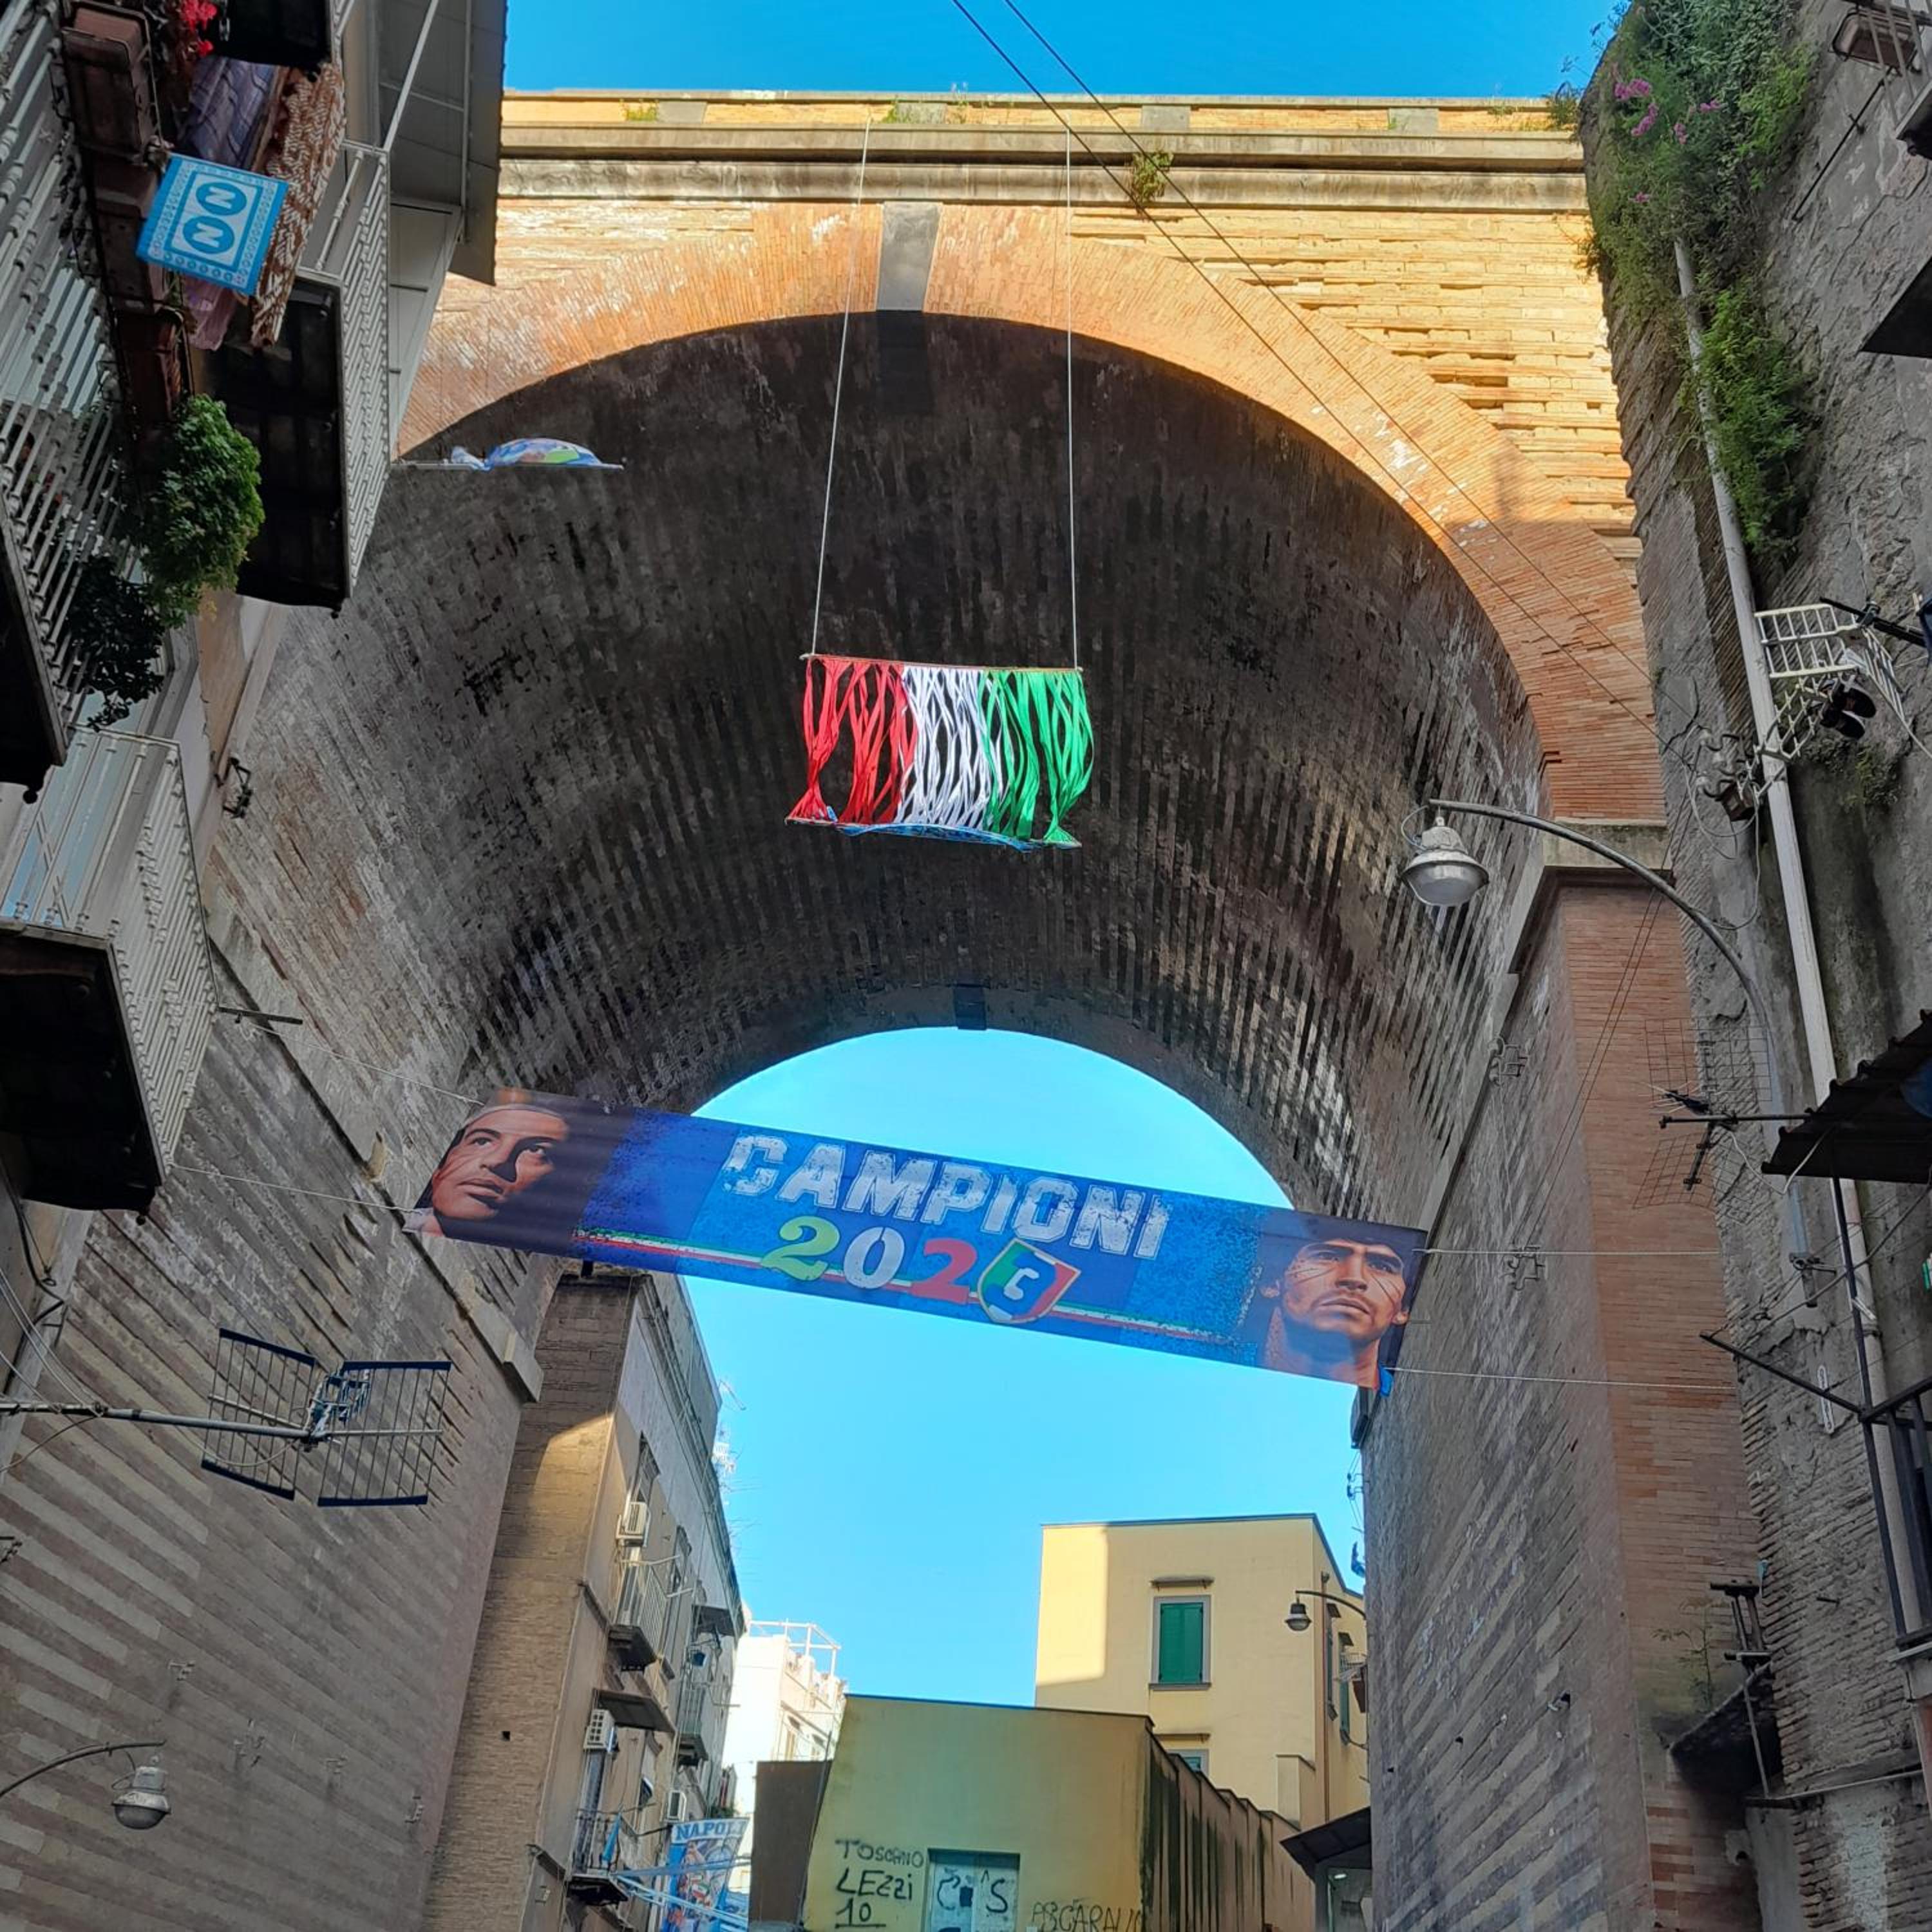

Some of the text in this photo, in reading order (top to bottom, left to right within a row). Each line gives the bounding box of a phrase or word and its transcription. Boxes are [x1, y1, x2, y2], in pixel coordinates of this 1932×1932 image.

[721, 1132, 1172, 1261] CAMPIONI
[675, 1821, 747, 1841] NAPOLI
[836, 1897, 873, 1926] 10
